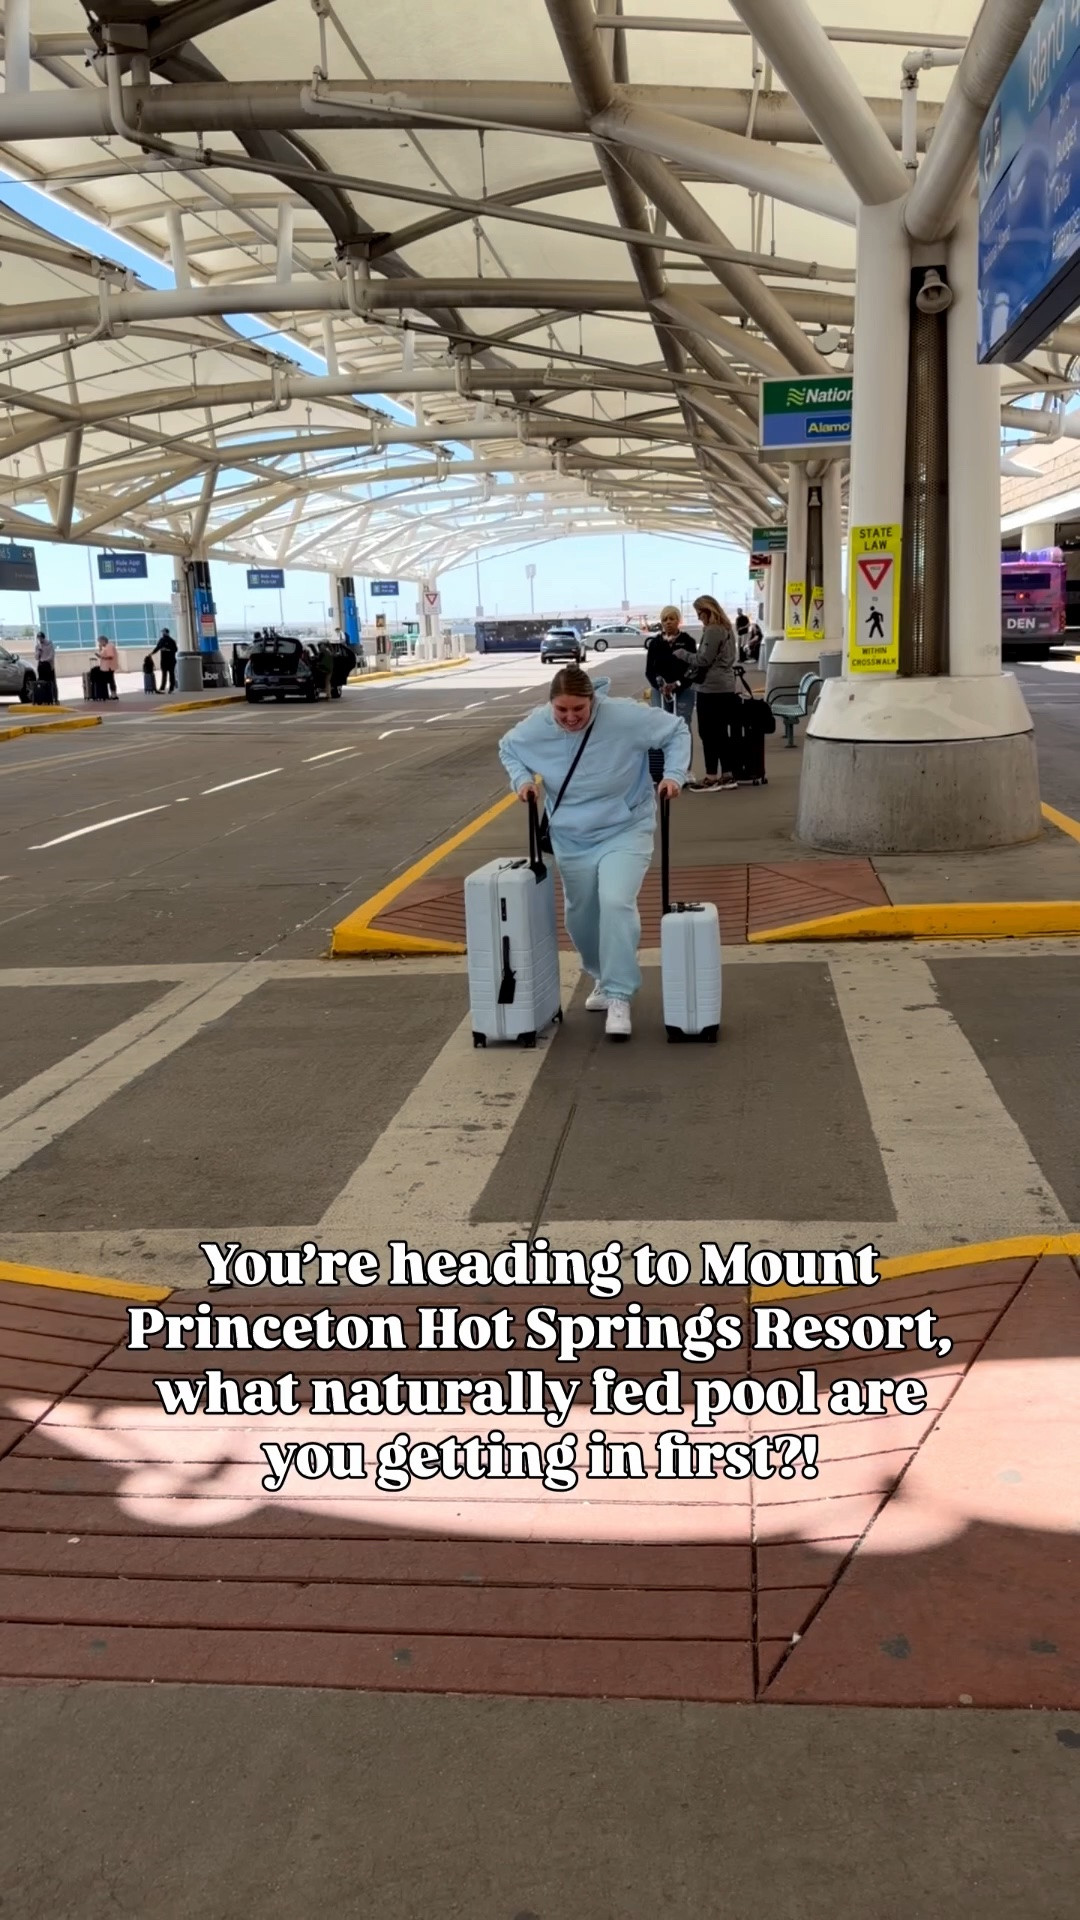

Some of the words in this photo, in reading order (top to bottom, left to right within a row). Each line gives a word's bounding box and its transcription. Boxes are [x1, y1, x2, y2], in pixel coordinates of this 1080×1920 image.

[1028, 0, 1066, 111] Island
[808, 422, 849, 433] Alamo
[859, 527, 892, 539] STATE
[864, 540, 887, 551] LAW
[203, 604, 210, 613] H
[1007, 618, 1036, 629] DEN
[862, 647, 887, 656] WITHIN
[851, 658, 896, 667] CROSSWALK
